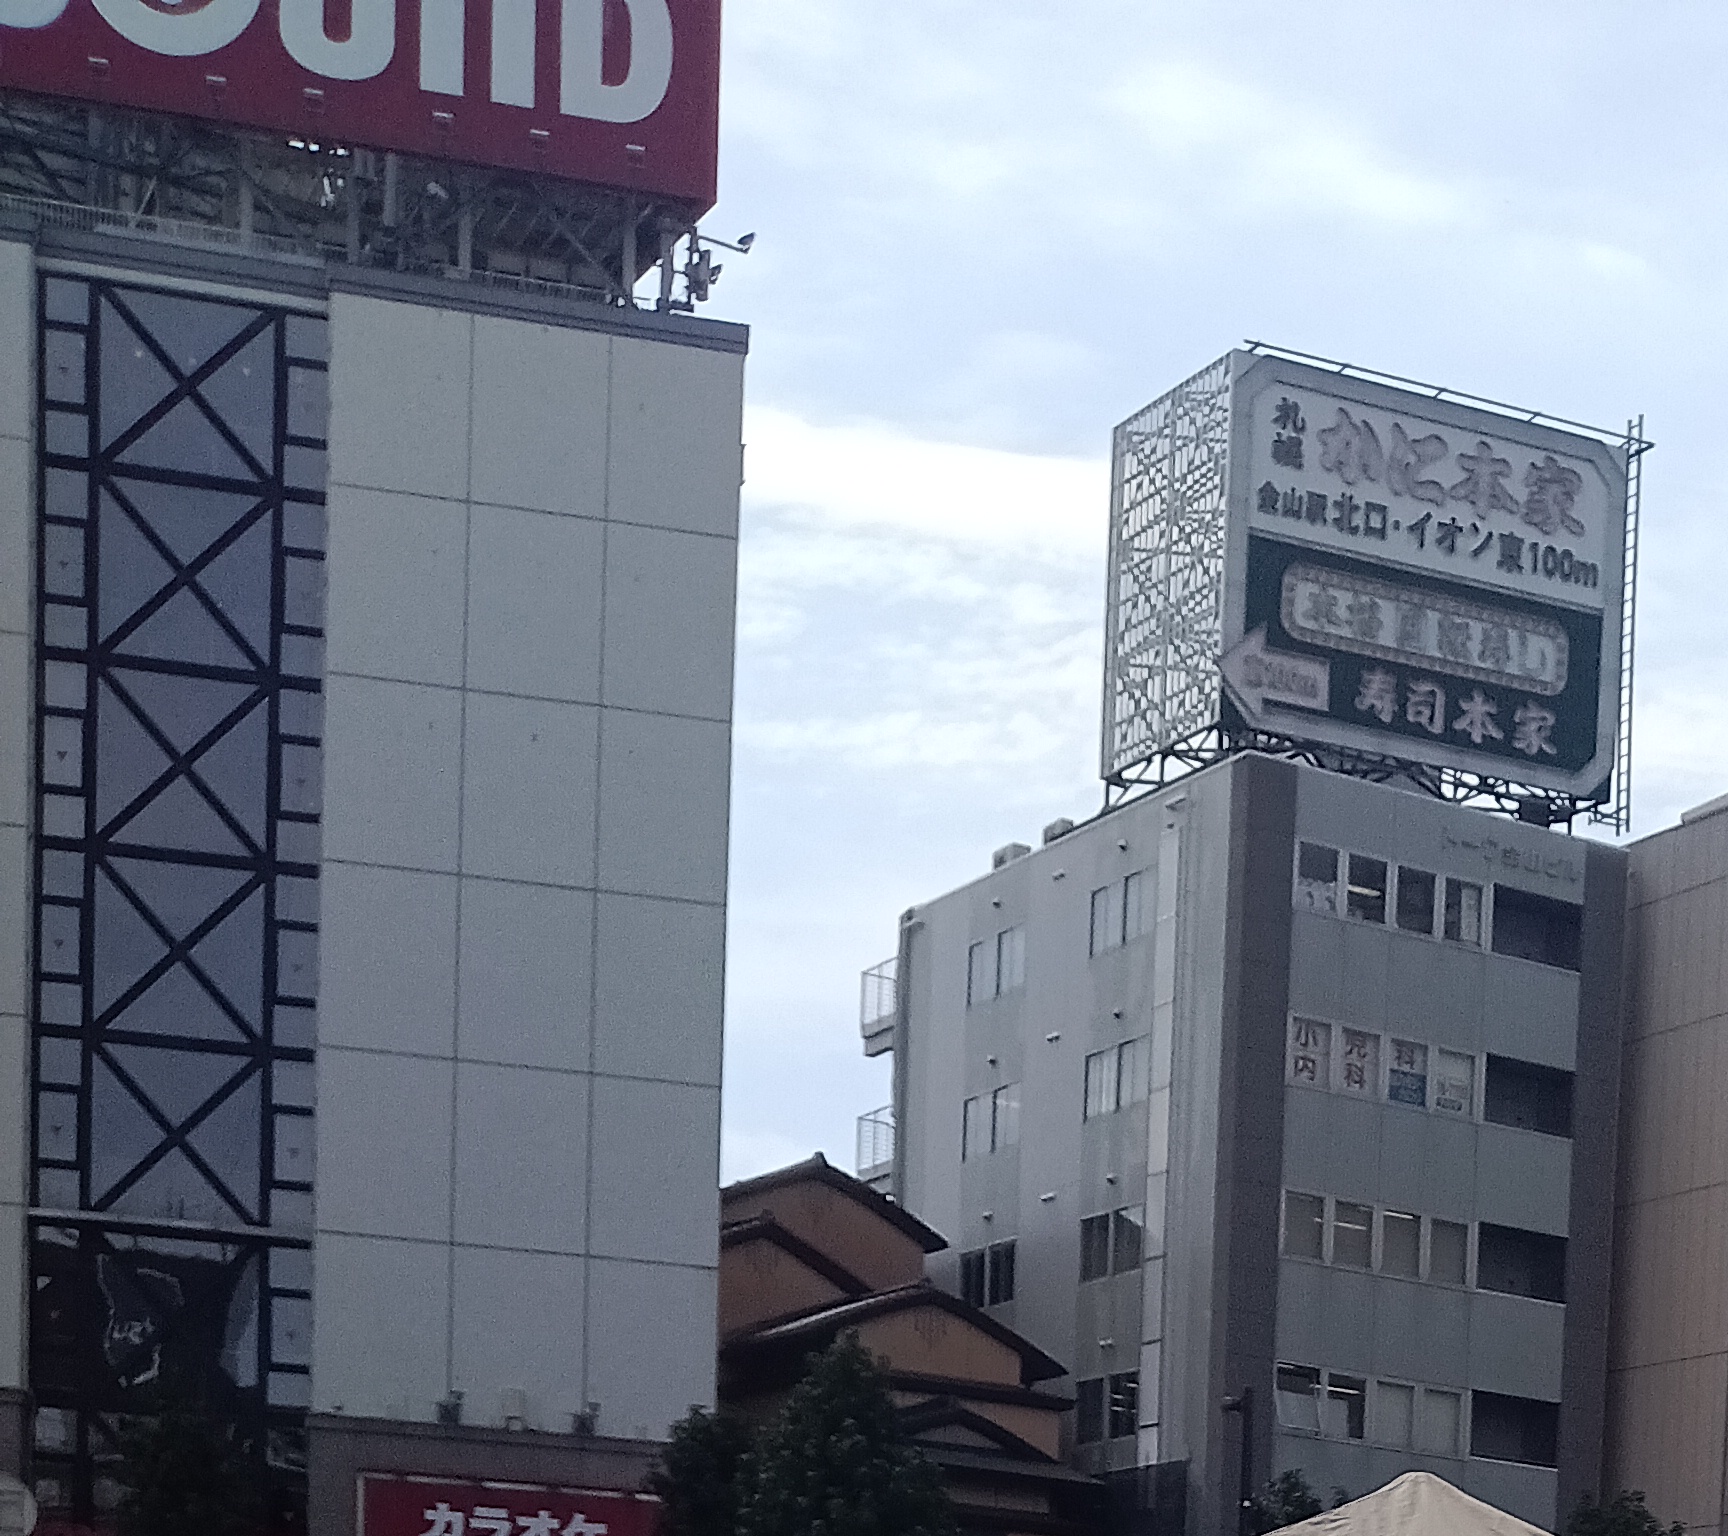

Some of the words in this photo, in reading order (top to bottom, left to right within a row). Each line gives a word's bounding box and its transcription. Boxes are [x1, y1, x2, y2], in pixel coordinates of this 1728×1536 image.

[1316, 406, 1587, 538] かに本家
[1354, 666, 1557, 756] 寿司本家
